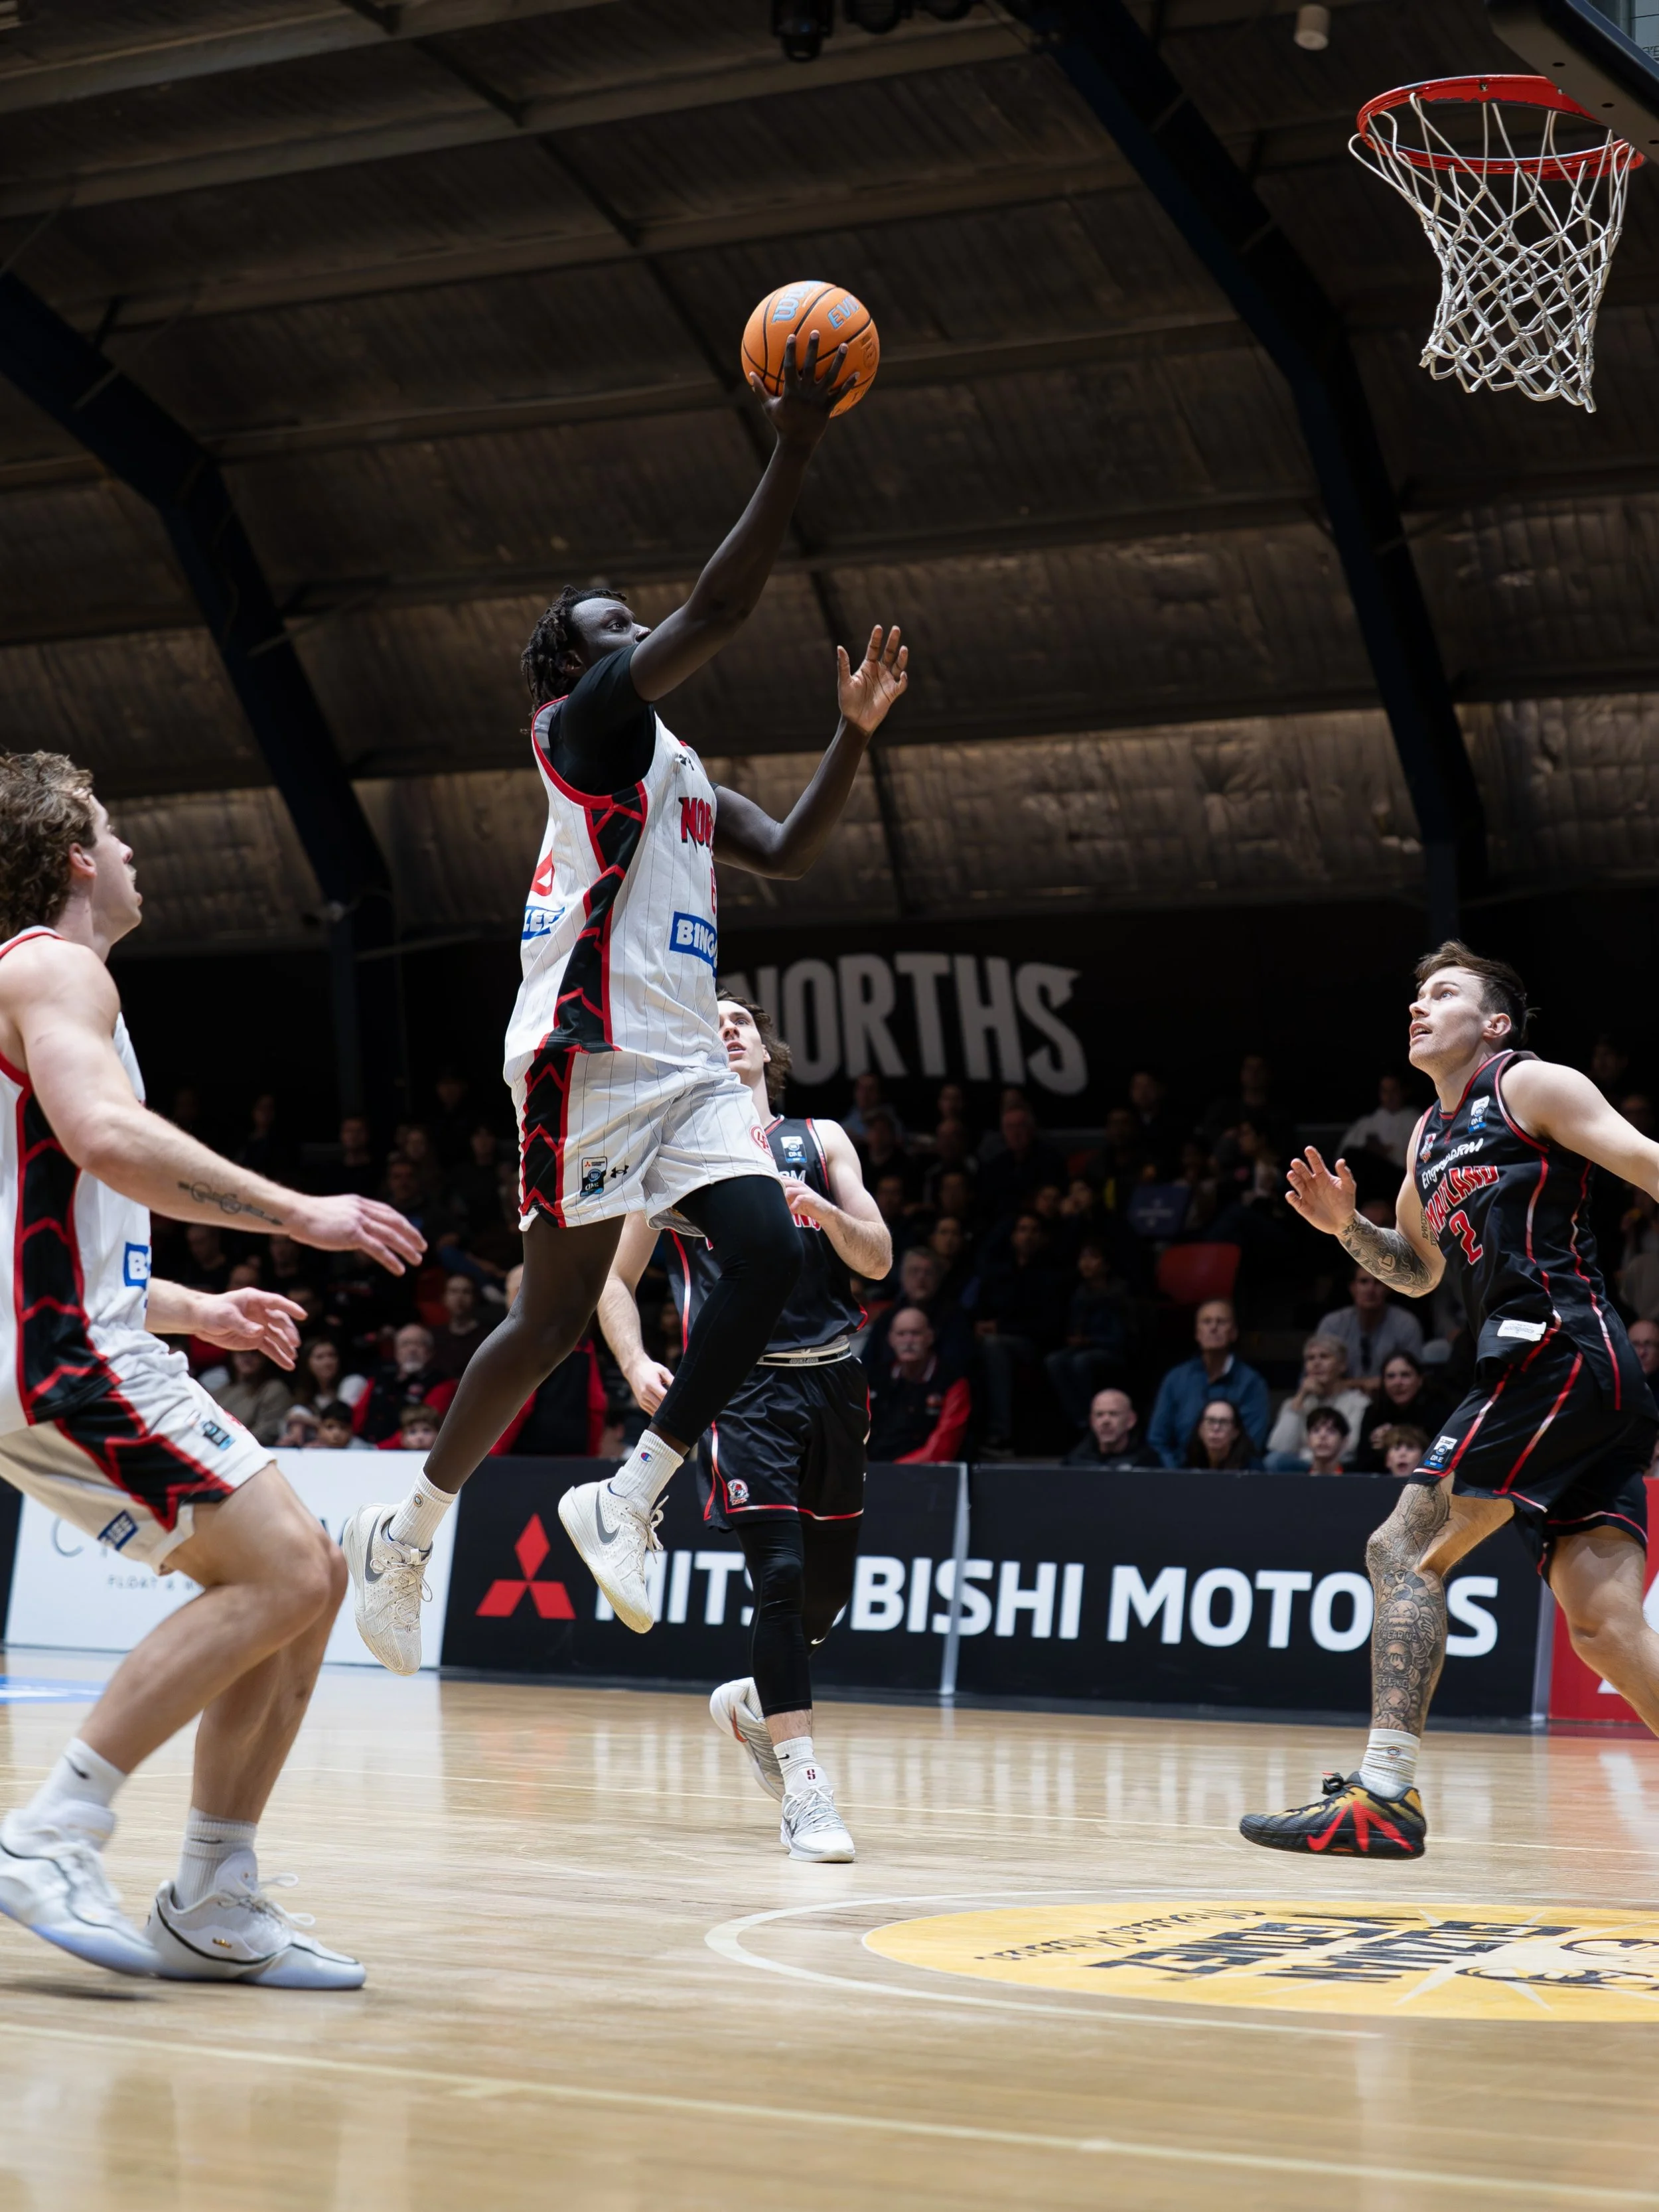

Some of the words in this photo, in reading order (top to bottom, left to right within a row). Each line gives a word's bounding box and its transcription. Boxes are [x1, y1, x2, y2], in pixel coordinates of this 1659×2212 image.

[1449, 1209, 1484, 1265] 2
[1108, 1566, 1498, 1656] MOTOS
[1085, 1922, 1399, 1974] GOMEZ
